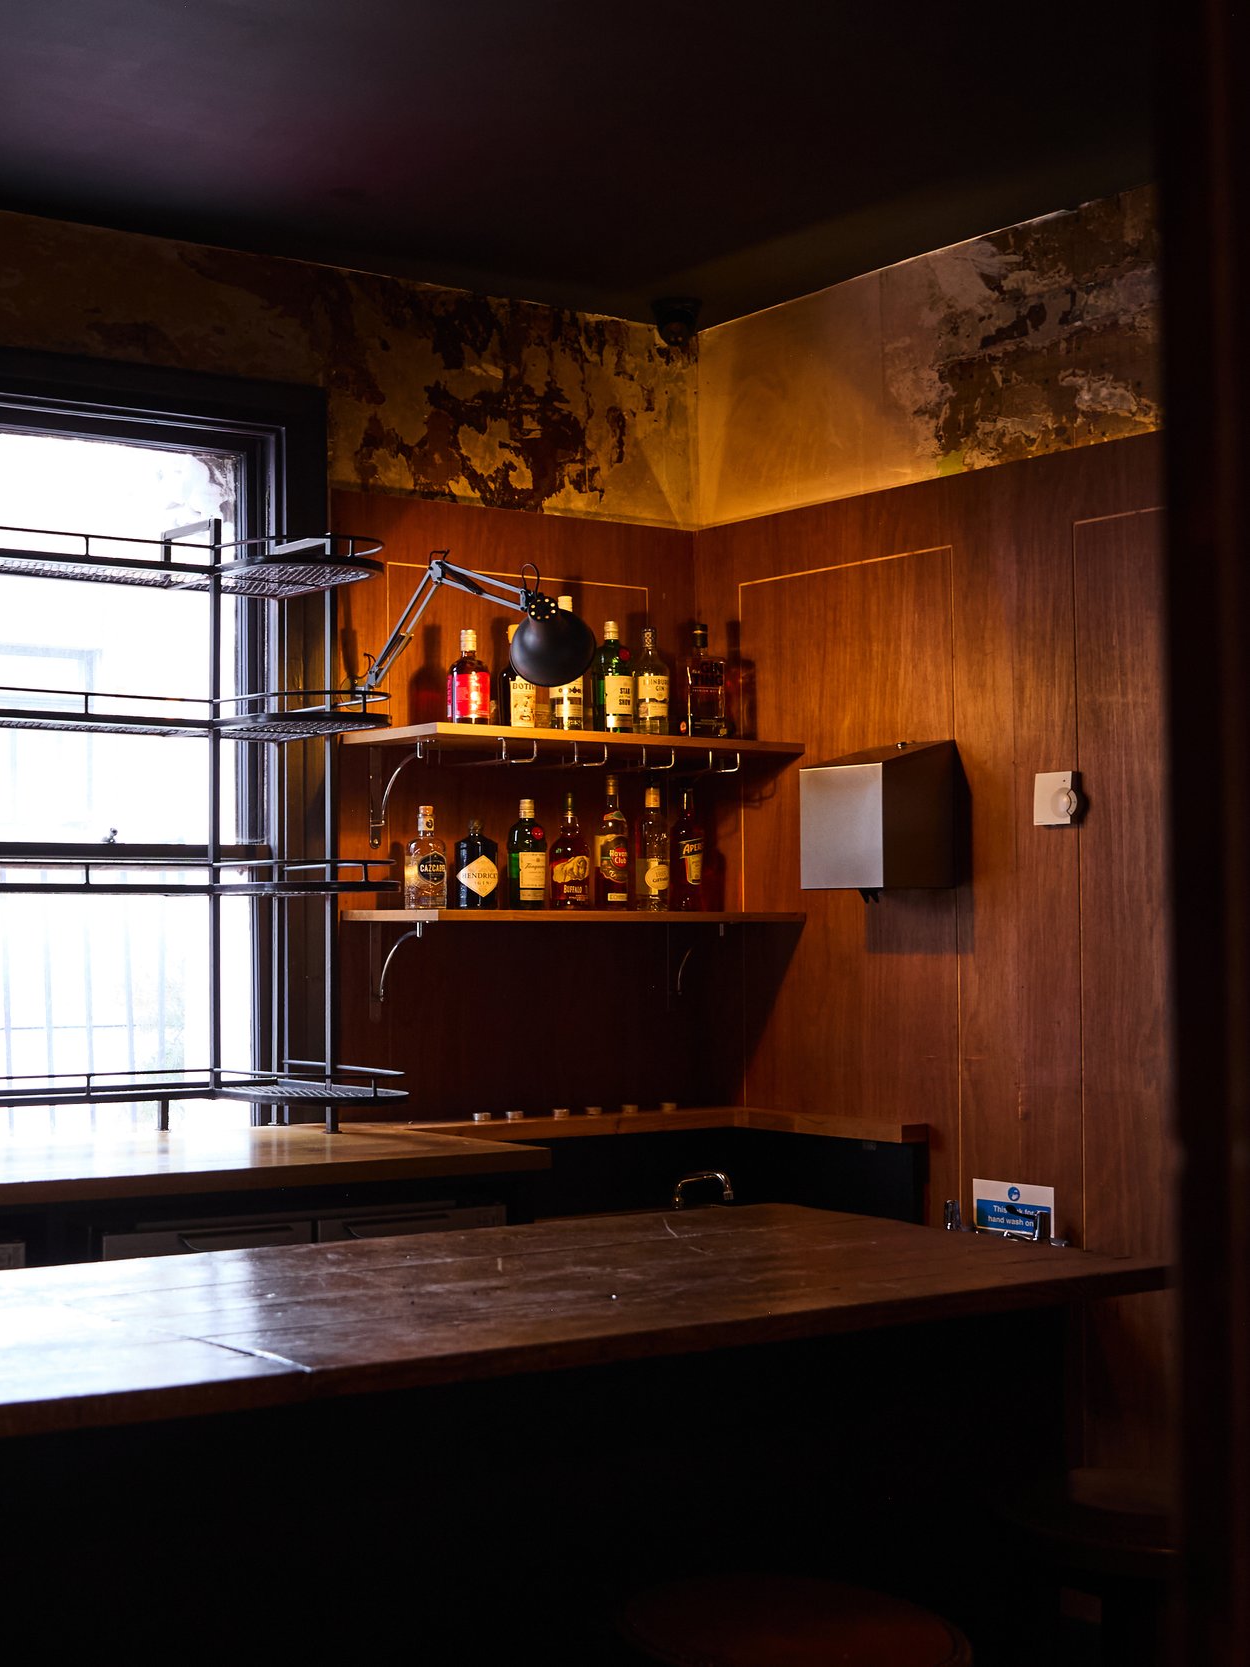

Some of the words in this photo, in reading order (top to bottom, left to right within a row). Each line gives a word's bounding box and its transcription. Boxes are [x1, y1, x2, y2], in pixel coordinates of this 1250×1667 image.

[993, 1205, 1008, 1213] This
[988, 1215, 1005, 1223] hand
[1006, 1218, 1024, 1226] wash
[1025, 1219, 1035, 1227] on
